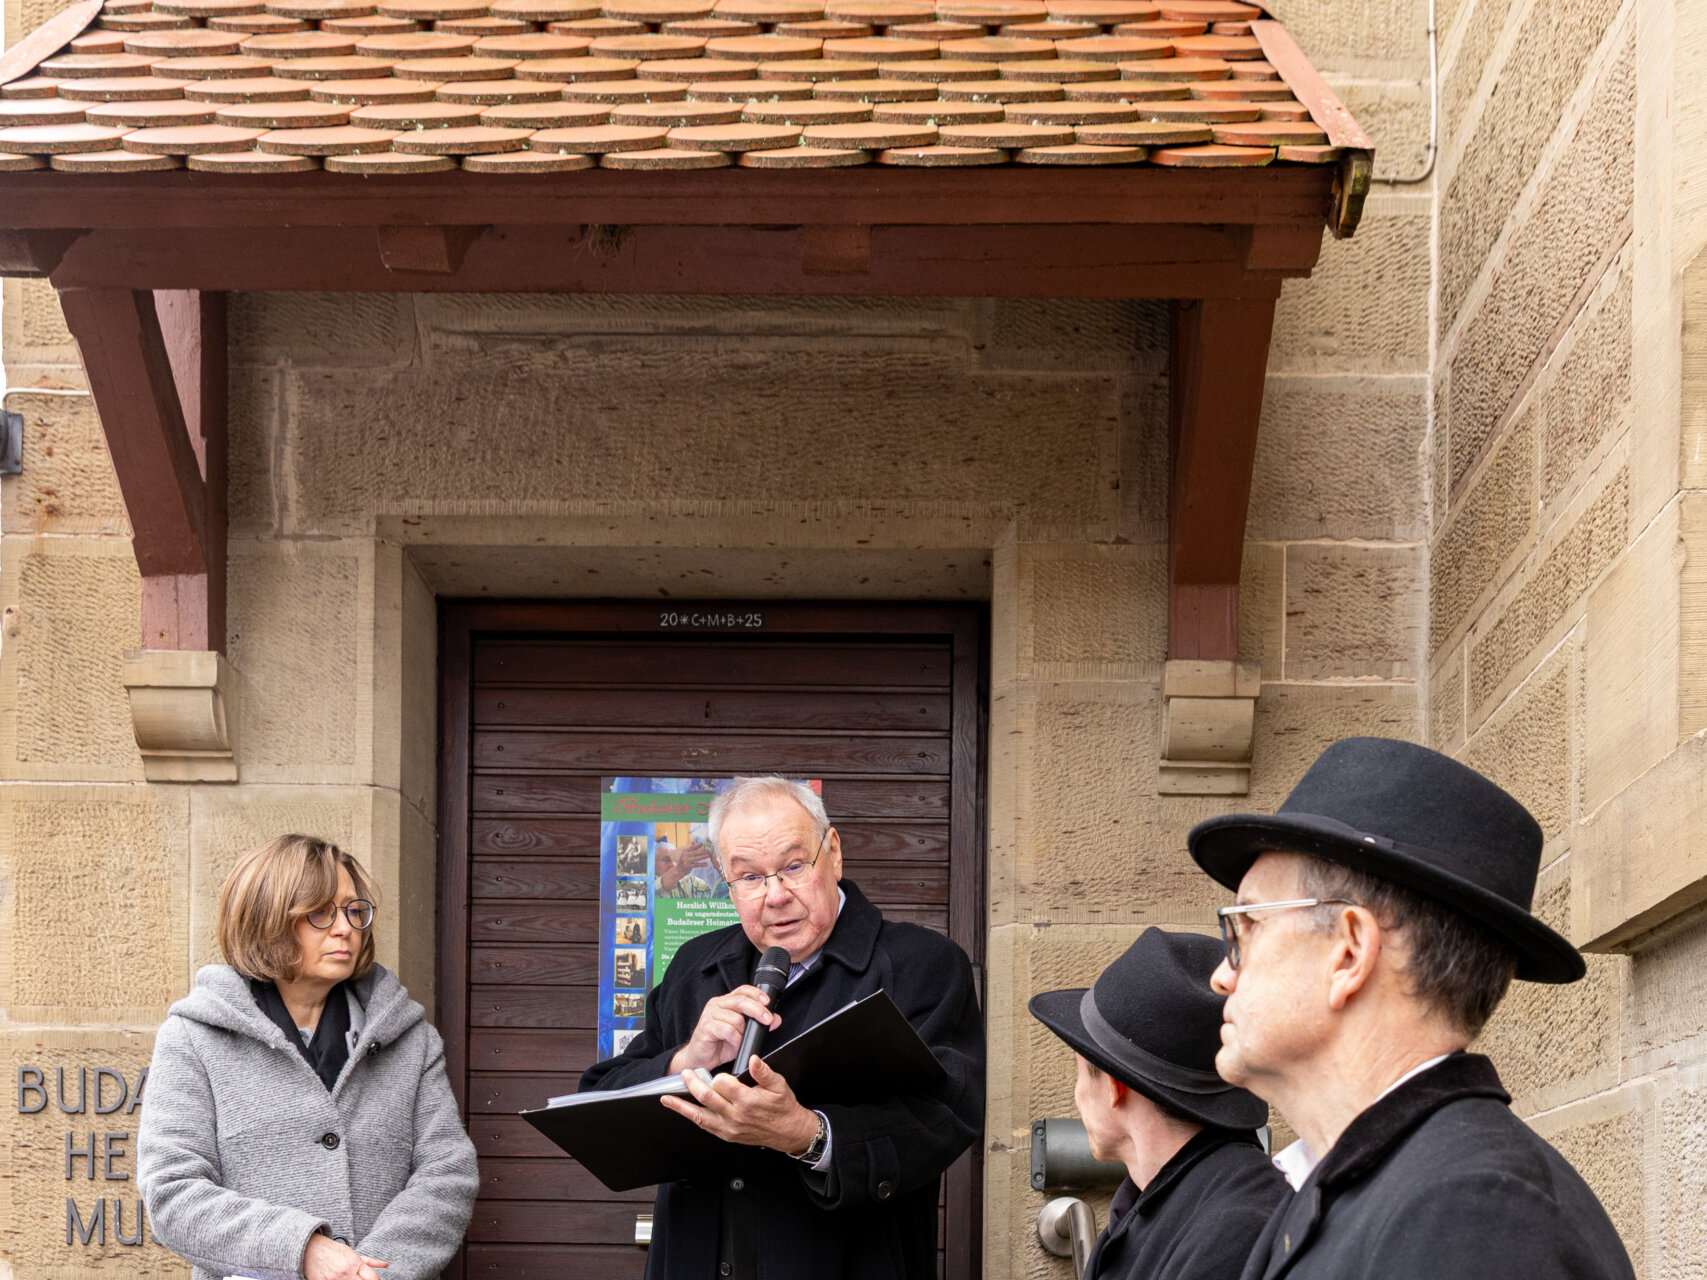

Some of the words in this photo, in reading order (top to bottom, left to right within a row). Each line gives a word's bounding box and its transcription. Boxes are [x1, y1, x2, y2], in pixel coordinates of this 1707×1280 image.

[667, 918, 705, 926] Budaörser
[65, 1132, 129, 1180] HE
[66, 1198, 162, 1246] MU
